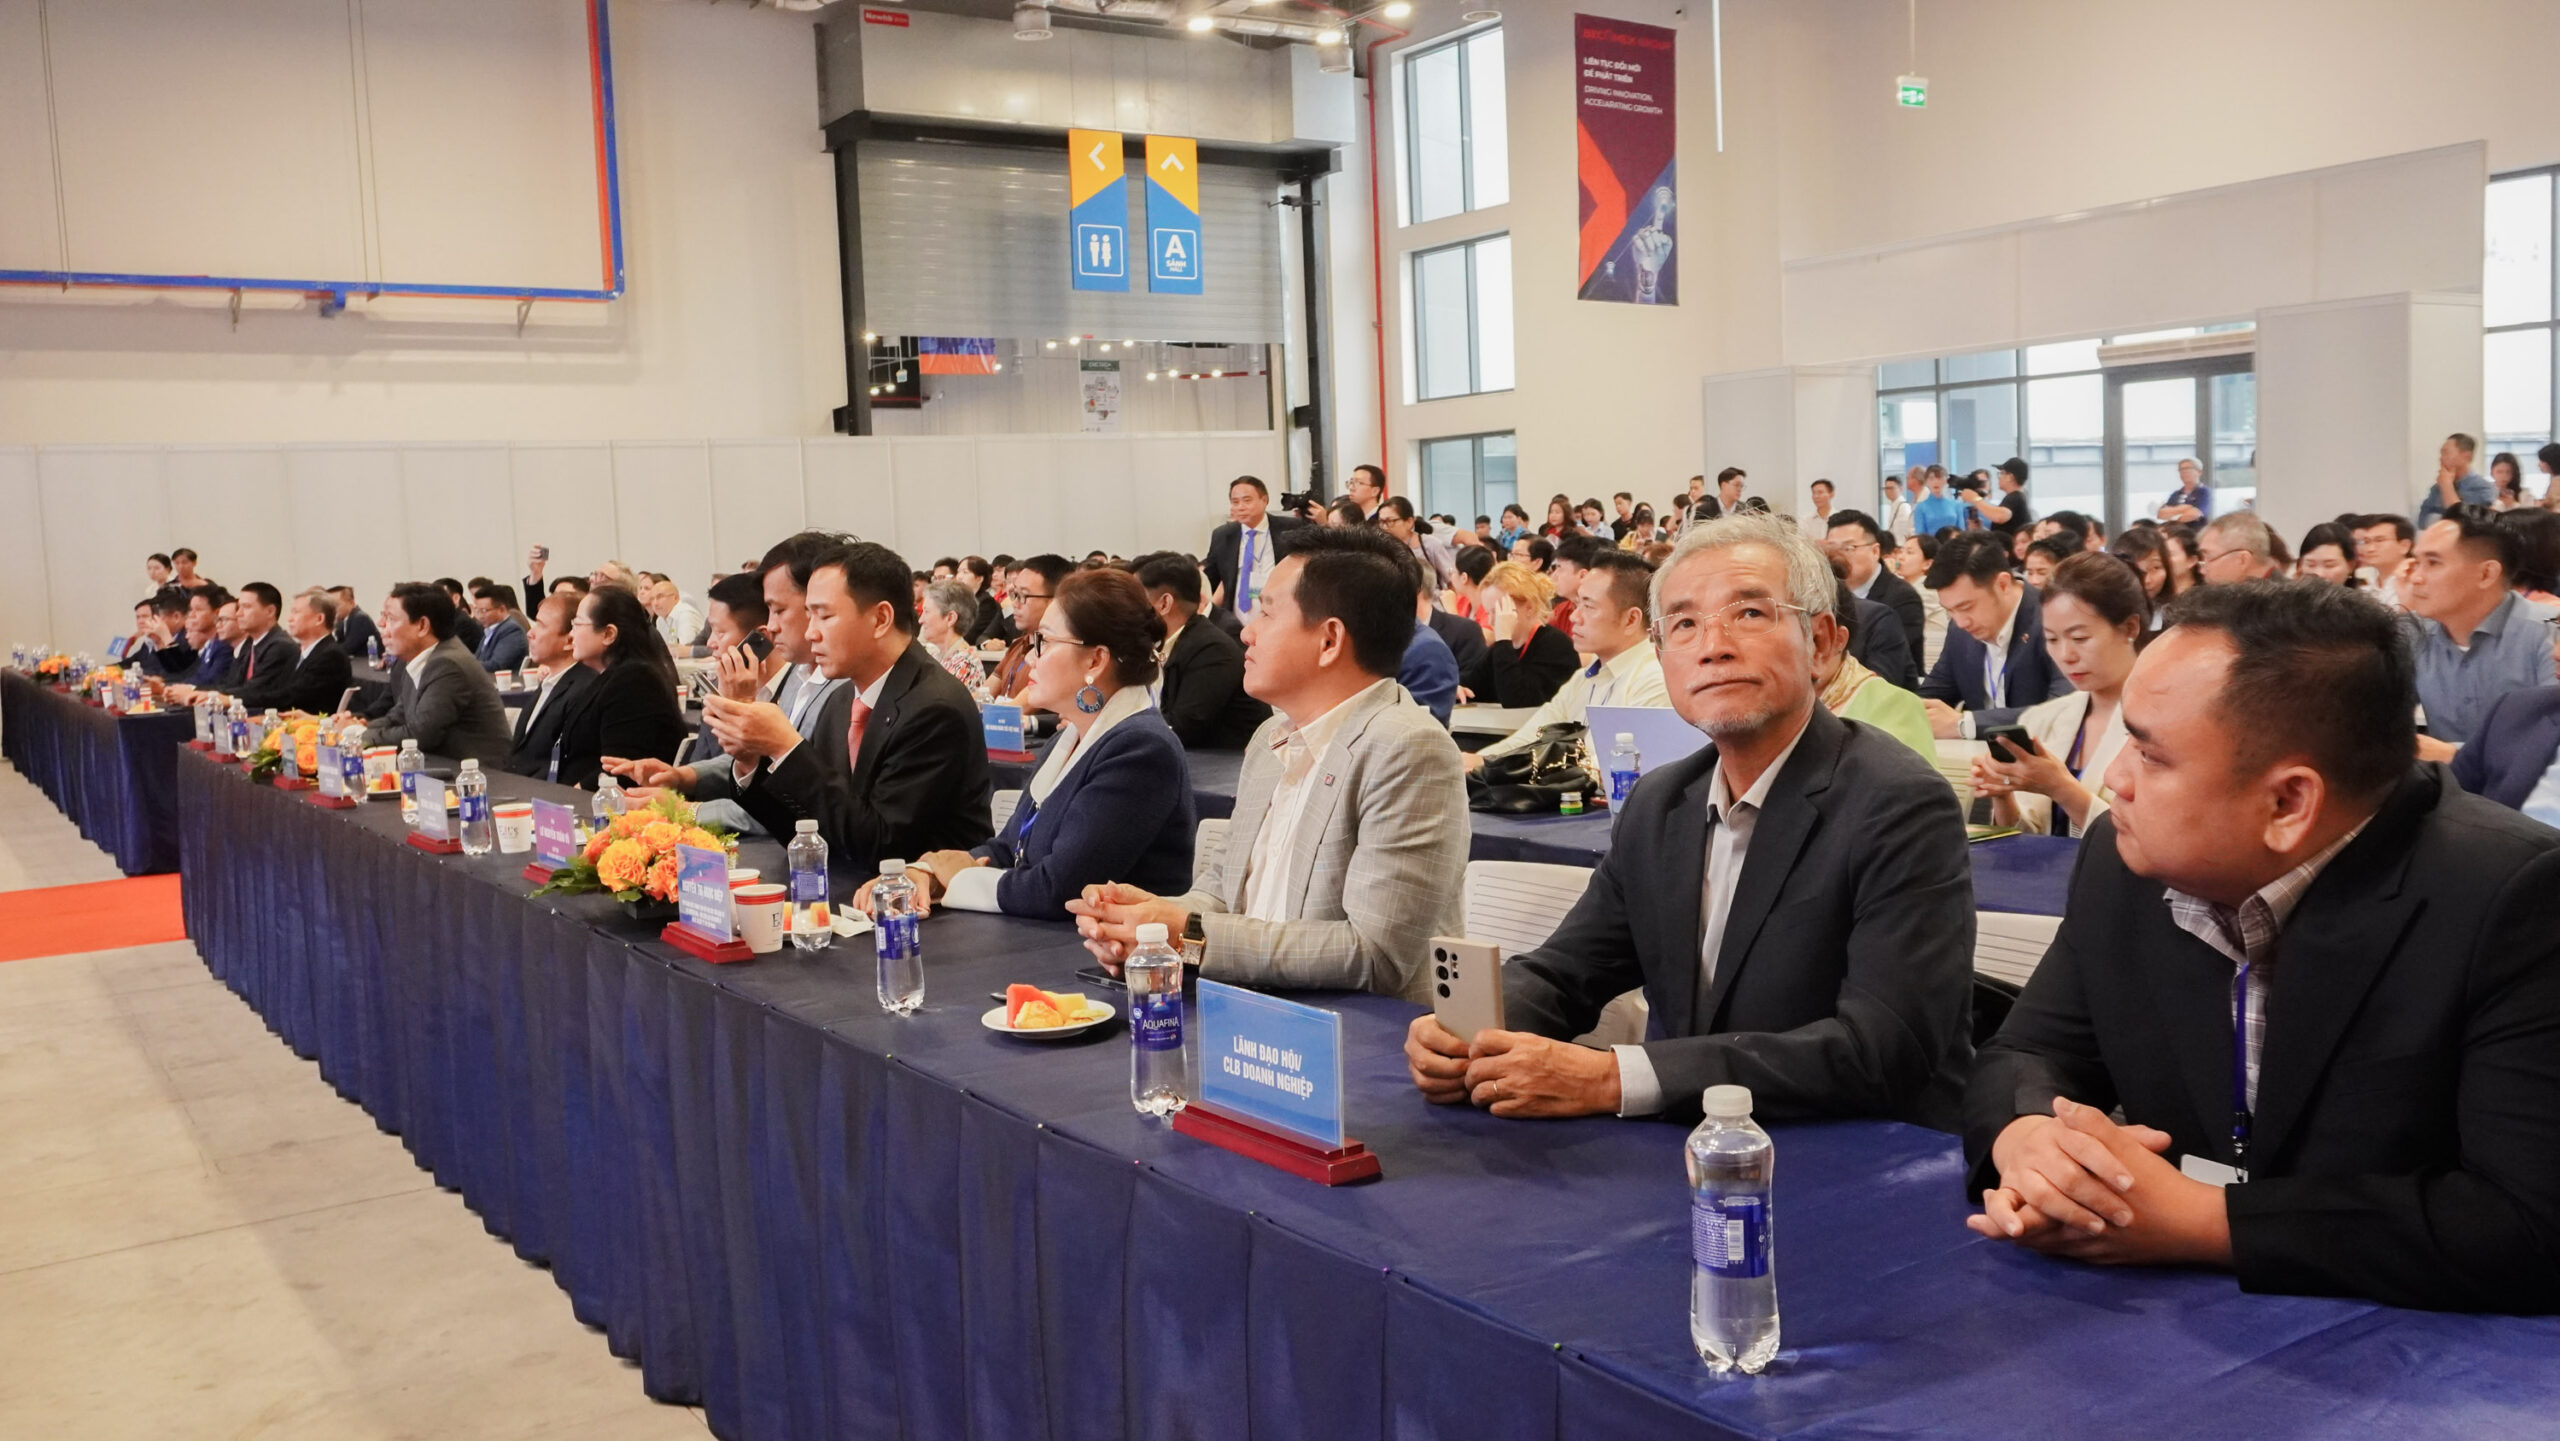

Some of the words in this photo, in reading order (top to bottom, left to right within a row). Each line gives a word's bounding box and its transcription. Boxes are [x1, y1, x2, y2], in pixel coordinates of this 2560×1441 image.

[1165, 234, 1186, 258] A
[1142, 1016, 1180, 1031] AQUAFINA
[1233, 1034, 1257, 1059] LÃNH
[1259, 1043, 1279, 1068] ĐẠO
[1223, 1056, 1241, 1077] CLB
[1243, 1062, 1275, 1088] DOANH
[1277, 1072, 1314, 1101] NGHIỆP
